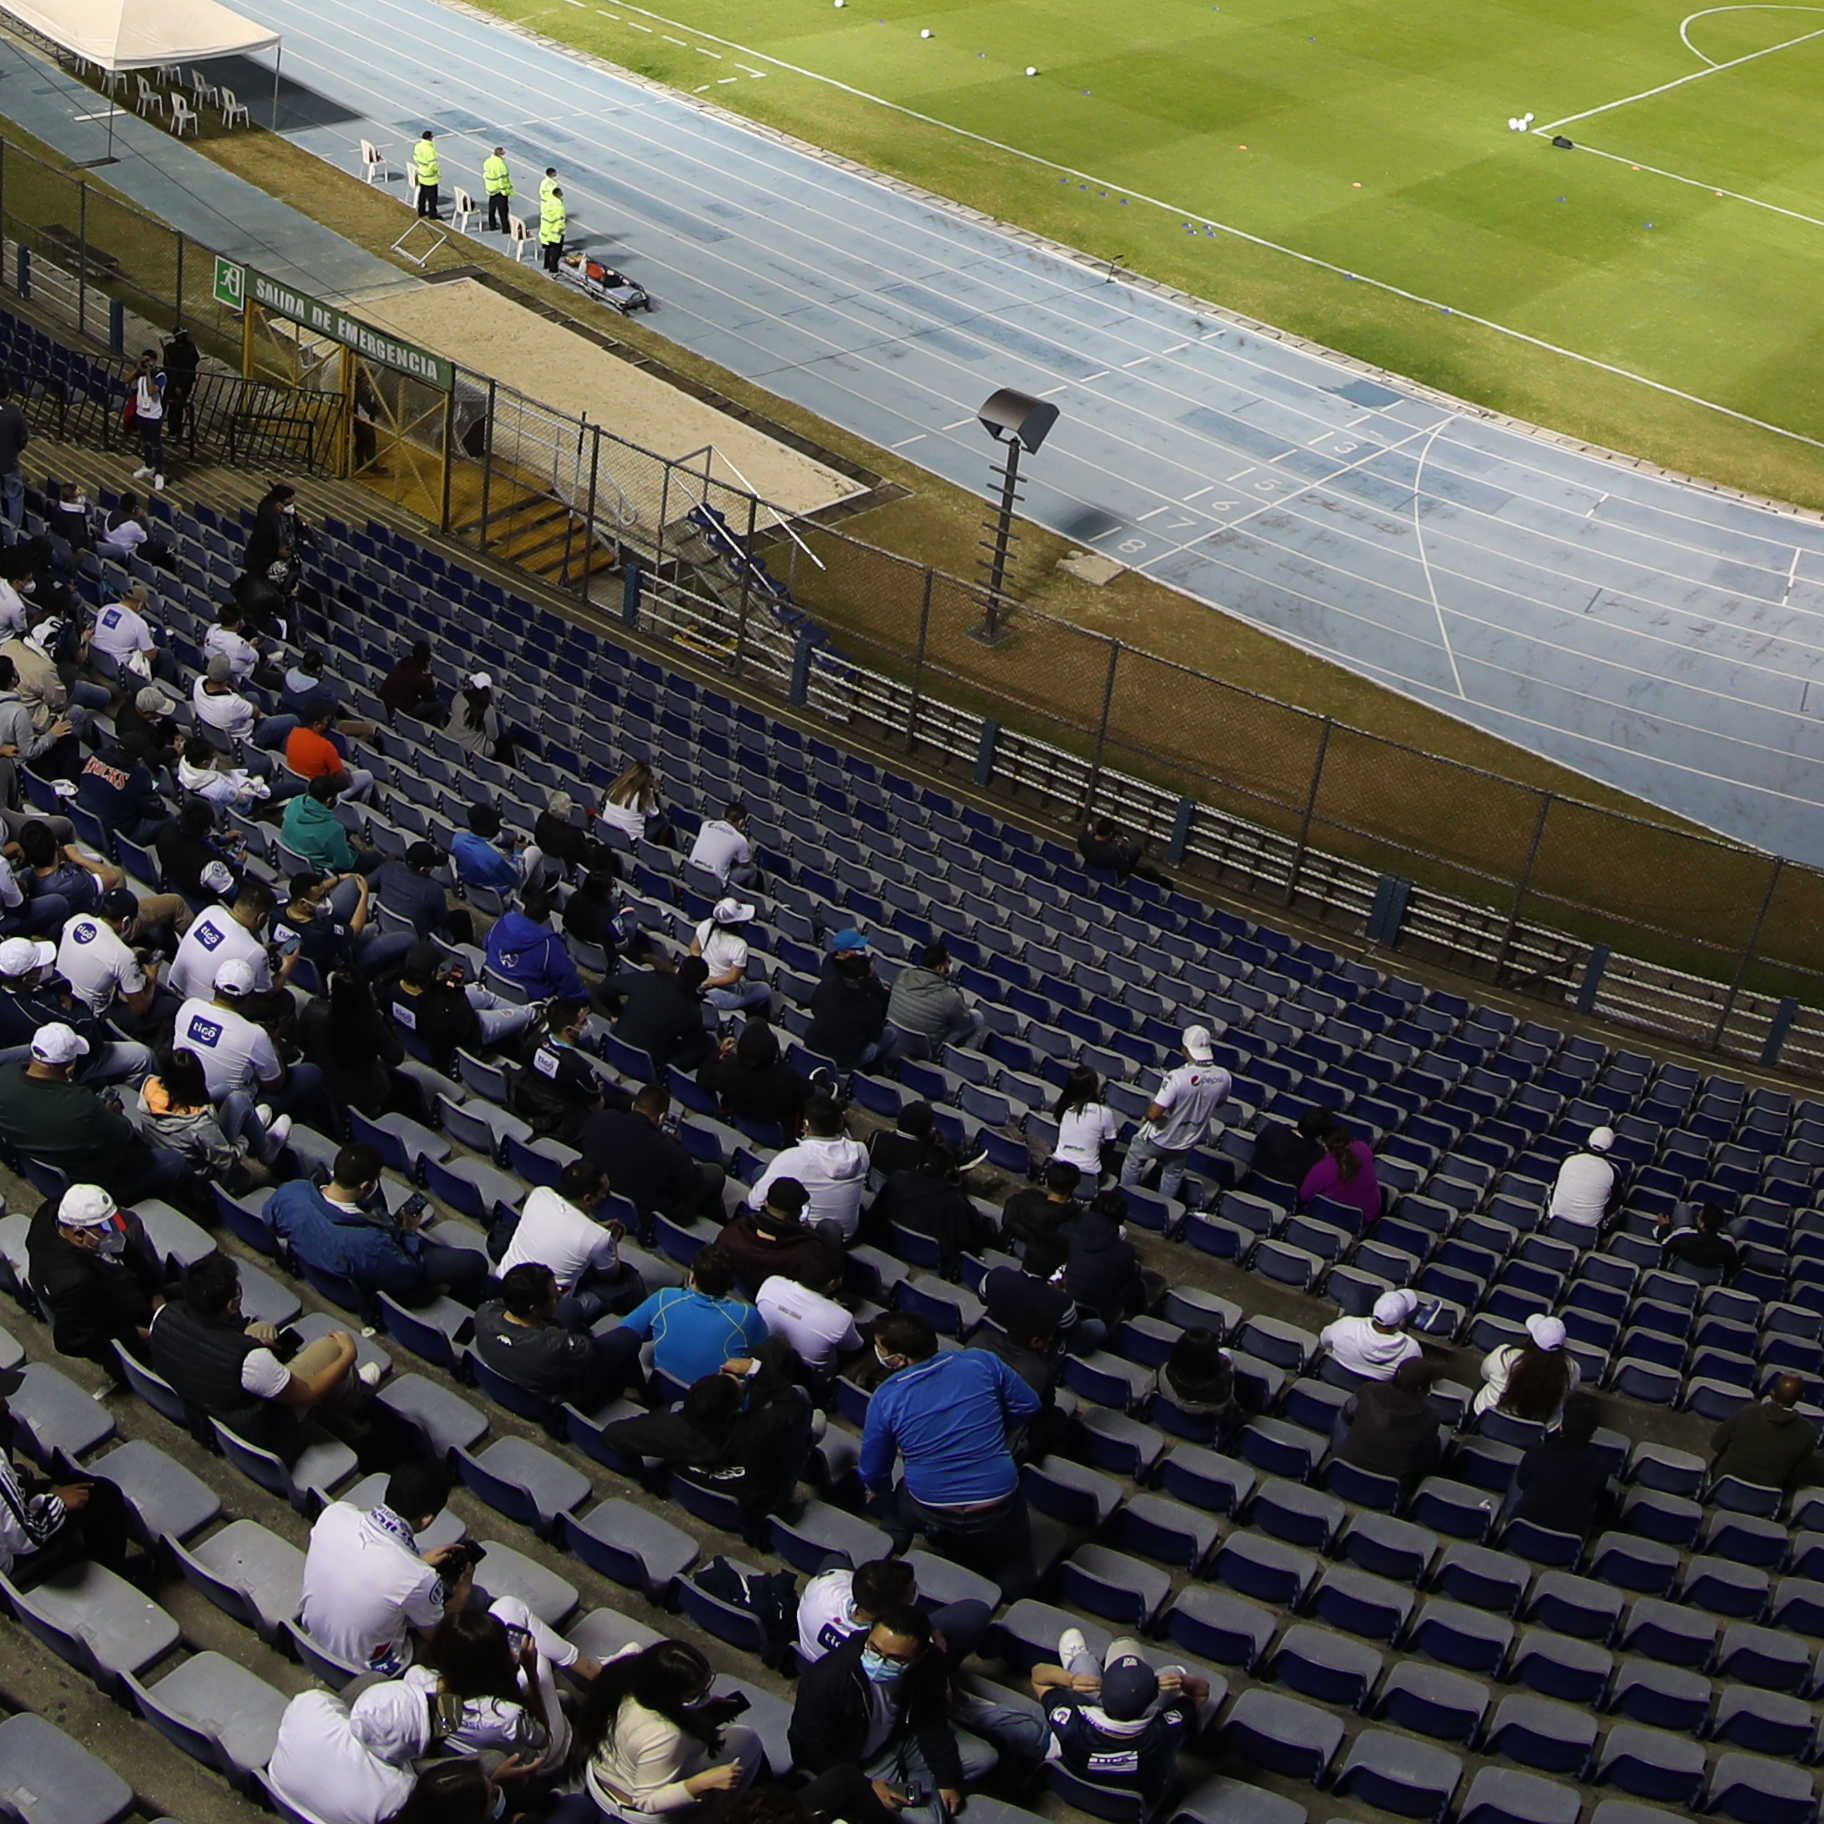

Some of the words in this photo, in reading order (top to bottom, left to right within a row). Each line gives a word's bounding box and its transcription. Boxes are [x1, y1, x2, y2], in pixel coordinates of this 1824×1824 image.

[255, 277, 305, 320] SALIDA
[310, 299, 332, 330] DE
[336, 312, 439, 382] EMERGENCIA
[1334, 441, 1358, 455] 3
[1253, 478, 1278, 491] 5
[1210, 498, 1233, 512] 6
[1164, 515, 1197, 530] 7
[1116, 536, 1148, 554] 8
[193, 1021, 217, 1042] tigo
[1202, 1076, 1224, 1085] pepsi
